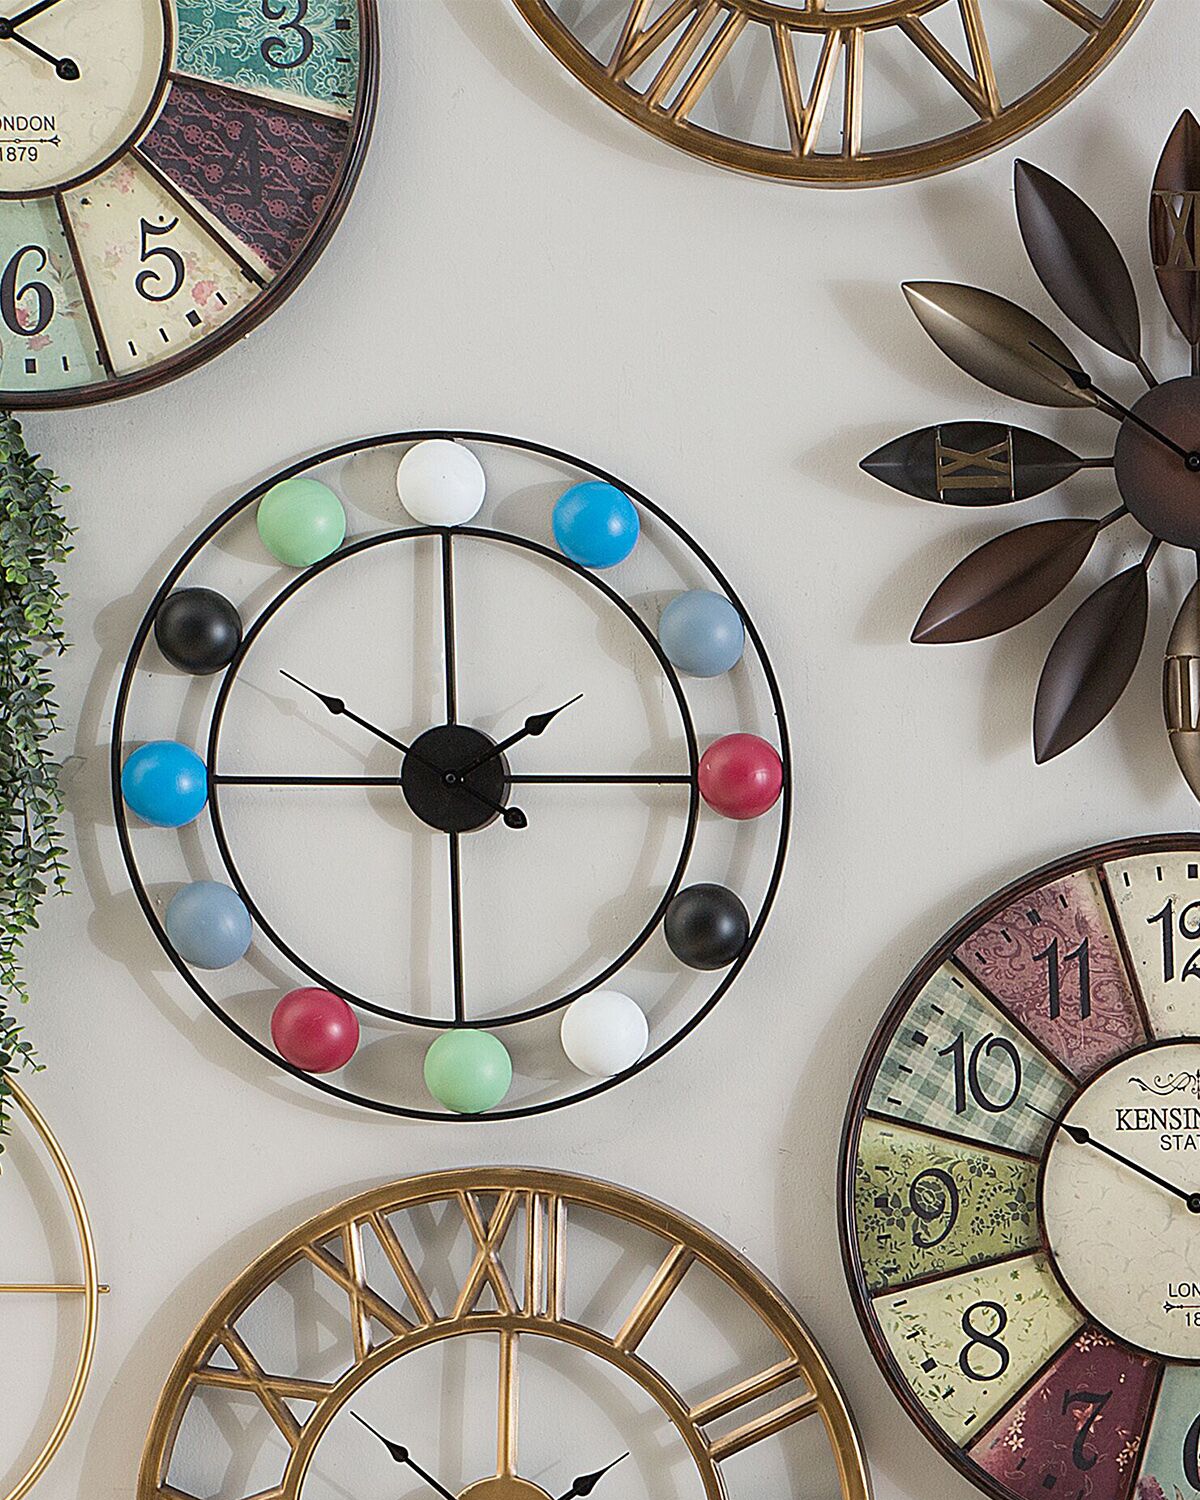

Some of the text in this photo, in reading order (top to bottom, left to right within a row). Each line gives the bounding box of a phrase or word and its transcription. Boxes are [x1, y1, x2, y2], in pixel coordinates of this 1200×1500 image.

[261, 0, 314, 68] 3
[0, 116, 55, 131] NDON
[0, 245, 54, 335] 6
[135, 216, 185, 301] 5
[1032, 935, 1092, 1021] 11
[937, 1030, 1022, 1116] 10
[909, 1168, 959, 1249] 9
[300, 1212, 440, 1362] XI
[455, 1190, 566, 1322] XII
[958, 1300, 1010, 1381] 8
[192, 1325, 338, 1450] X
[1061, 1389, 1114, 1472] 7
